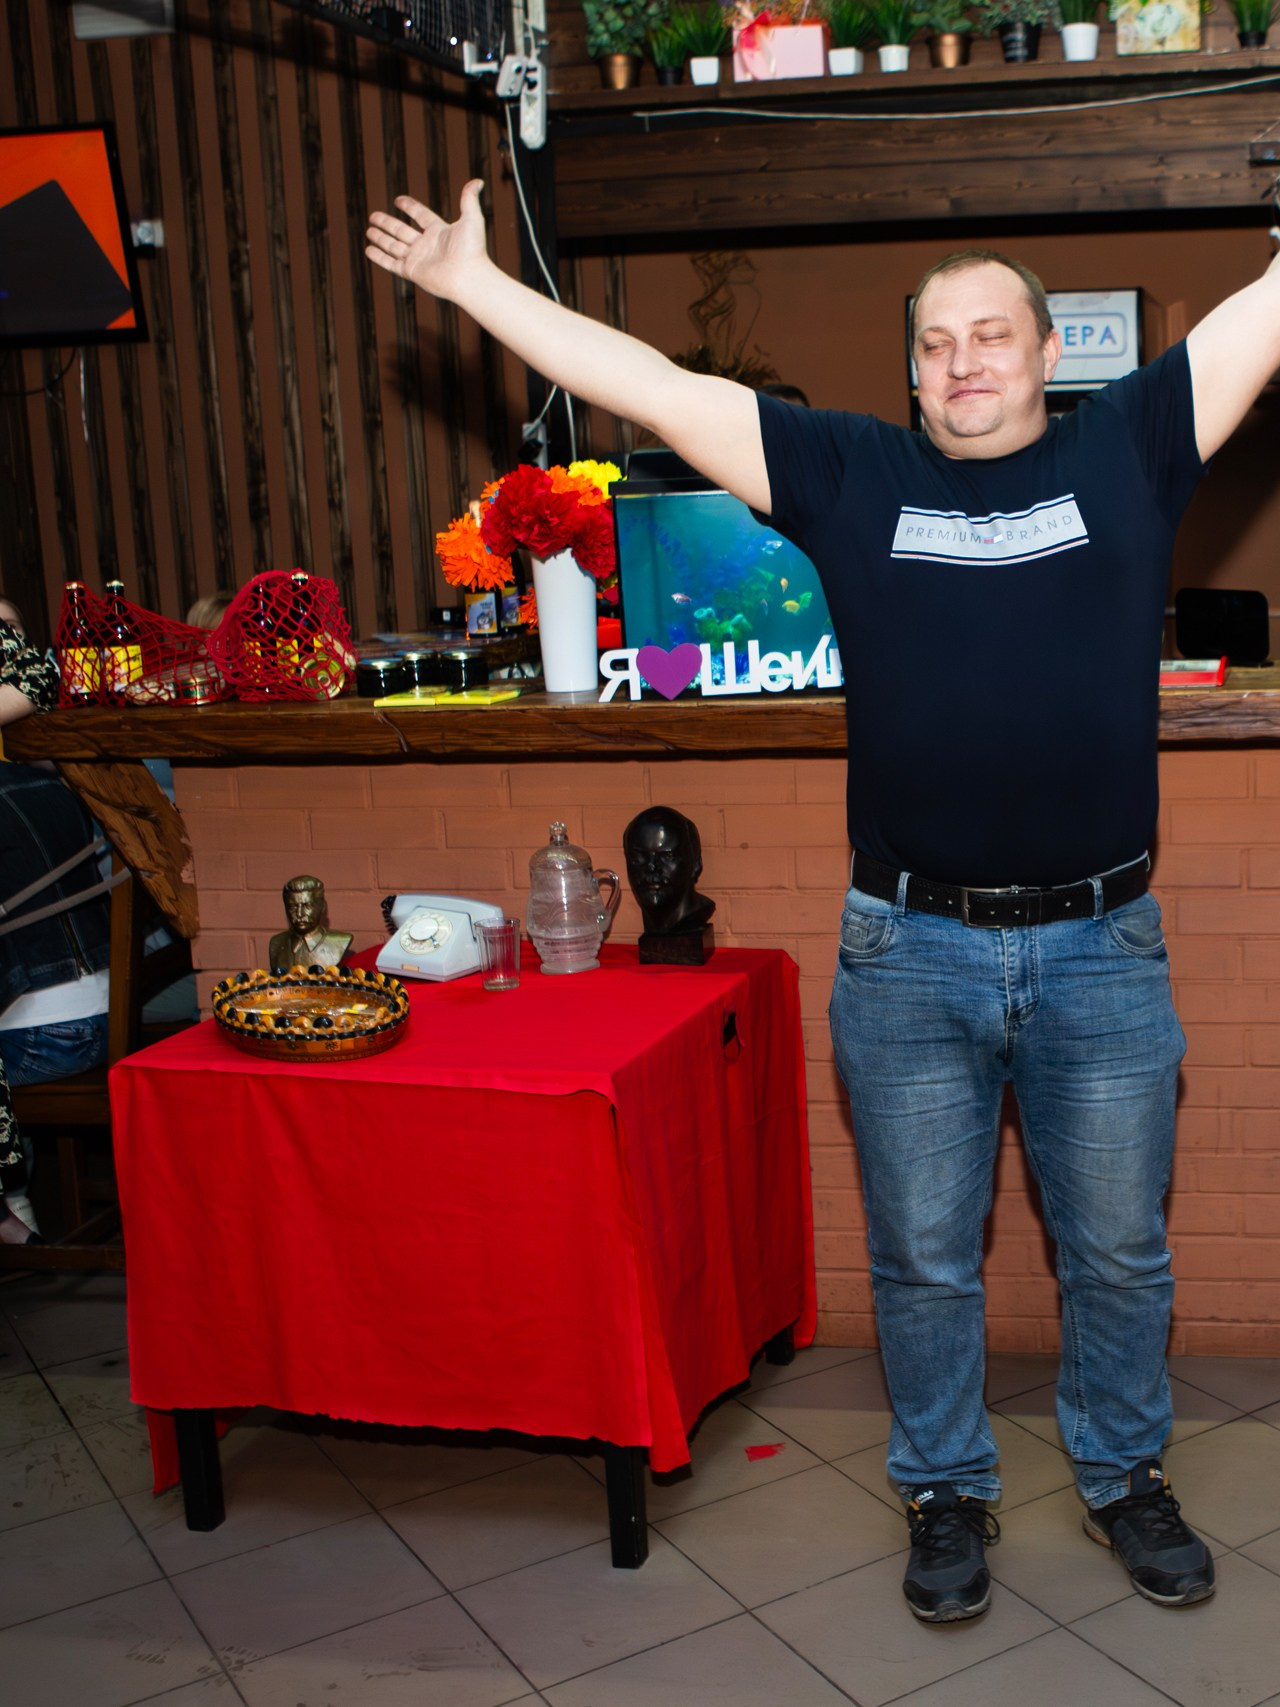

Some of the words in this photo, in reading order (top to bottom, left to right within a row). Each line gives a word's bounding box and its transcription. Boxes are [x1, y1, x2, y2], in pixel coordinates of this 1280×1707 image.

[1064, 325, 1117, 346] ЕРА
[906, 526, 981, 544] PREMIUM
[1006, 515, 1073, 541] BRAND
[599, 648, 641, 702] Я
